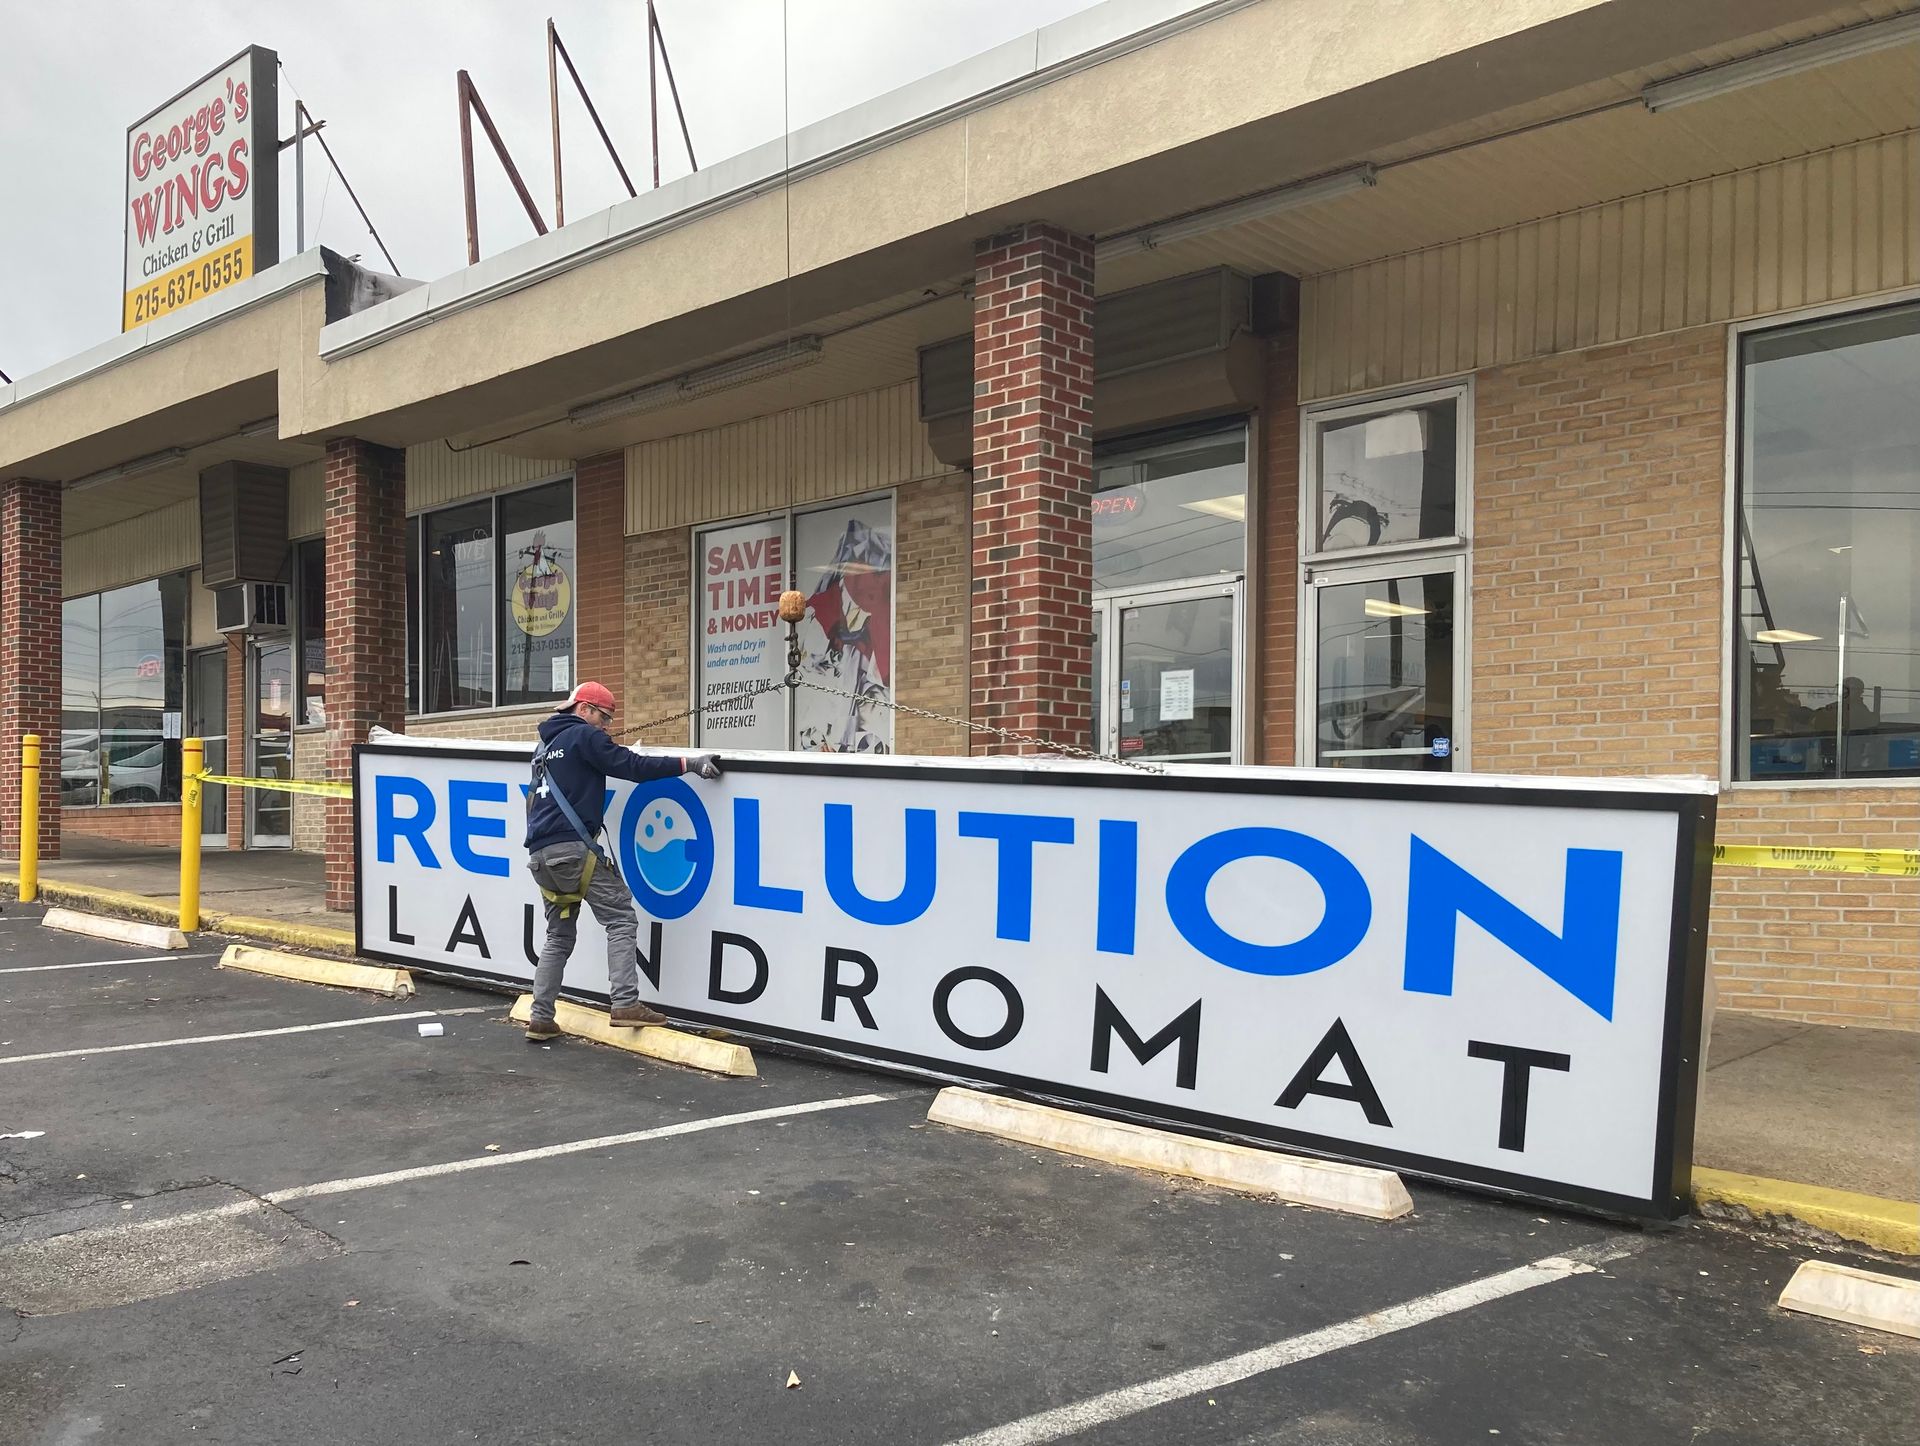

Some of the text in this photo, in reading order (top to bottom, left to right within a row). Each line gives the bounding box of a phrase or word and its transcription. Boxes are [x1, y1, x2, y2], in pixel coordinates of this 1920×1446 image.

[132, 77, 249, 181] George's
[131, 137, 249, 248] WINGS
[142, 214, 235, 277] Chicken & Grill
[135, 248, 243, 322] 215-637-0555
[1091, 496, 1136, 514] OPEN
[707, 536, 781, 576] SAVE
[707, 573, 781, 610] TIME
[707, 609, 780, 635] & MONEY
[707, 638, 766, 654] Wash and Dry in
[707, 657, 728, 668] under
[739, 653, 760, 665] hour!
[706, 678, 771, 696] EXPERIENCE THE
[706, 697, 755, 713] ELECTROLUX
[706, 714, 756, 730] DIFFERENCE!
[375, 775, 1623, 1023] REOLUTION
